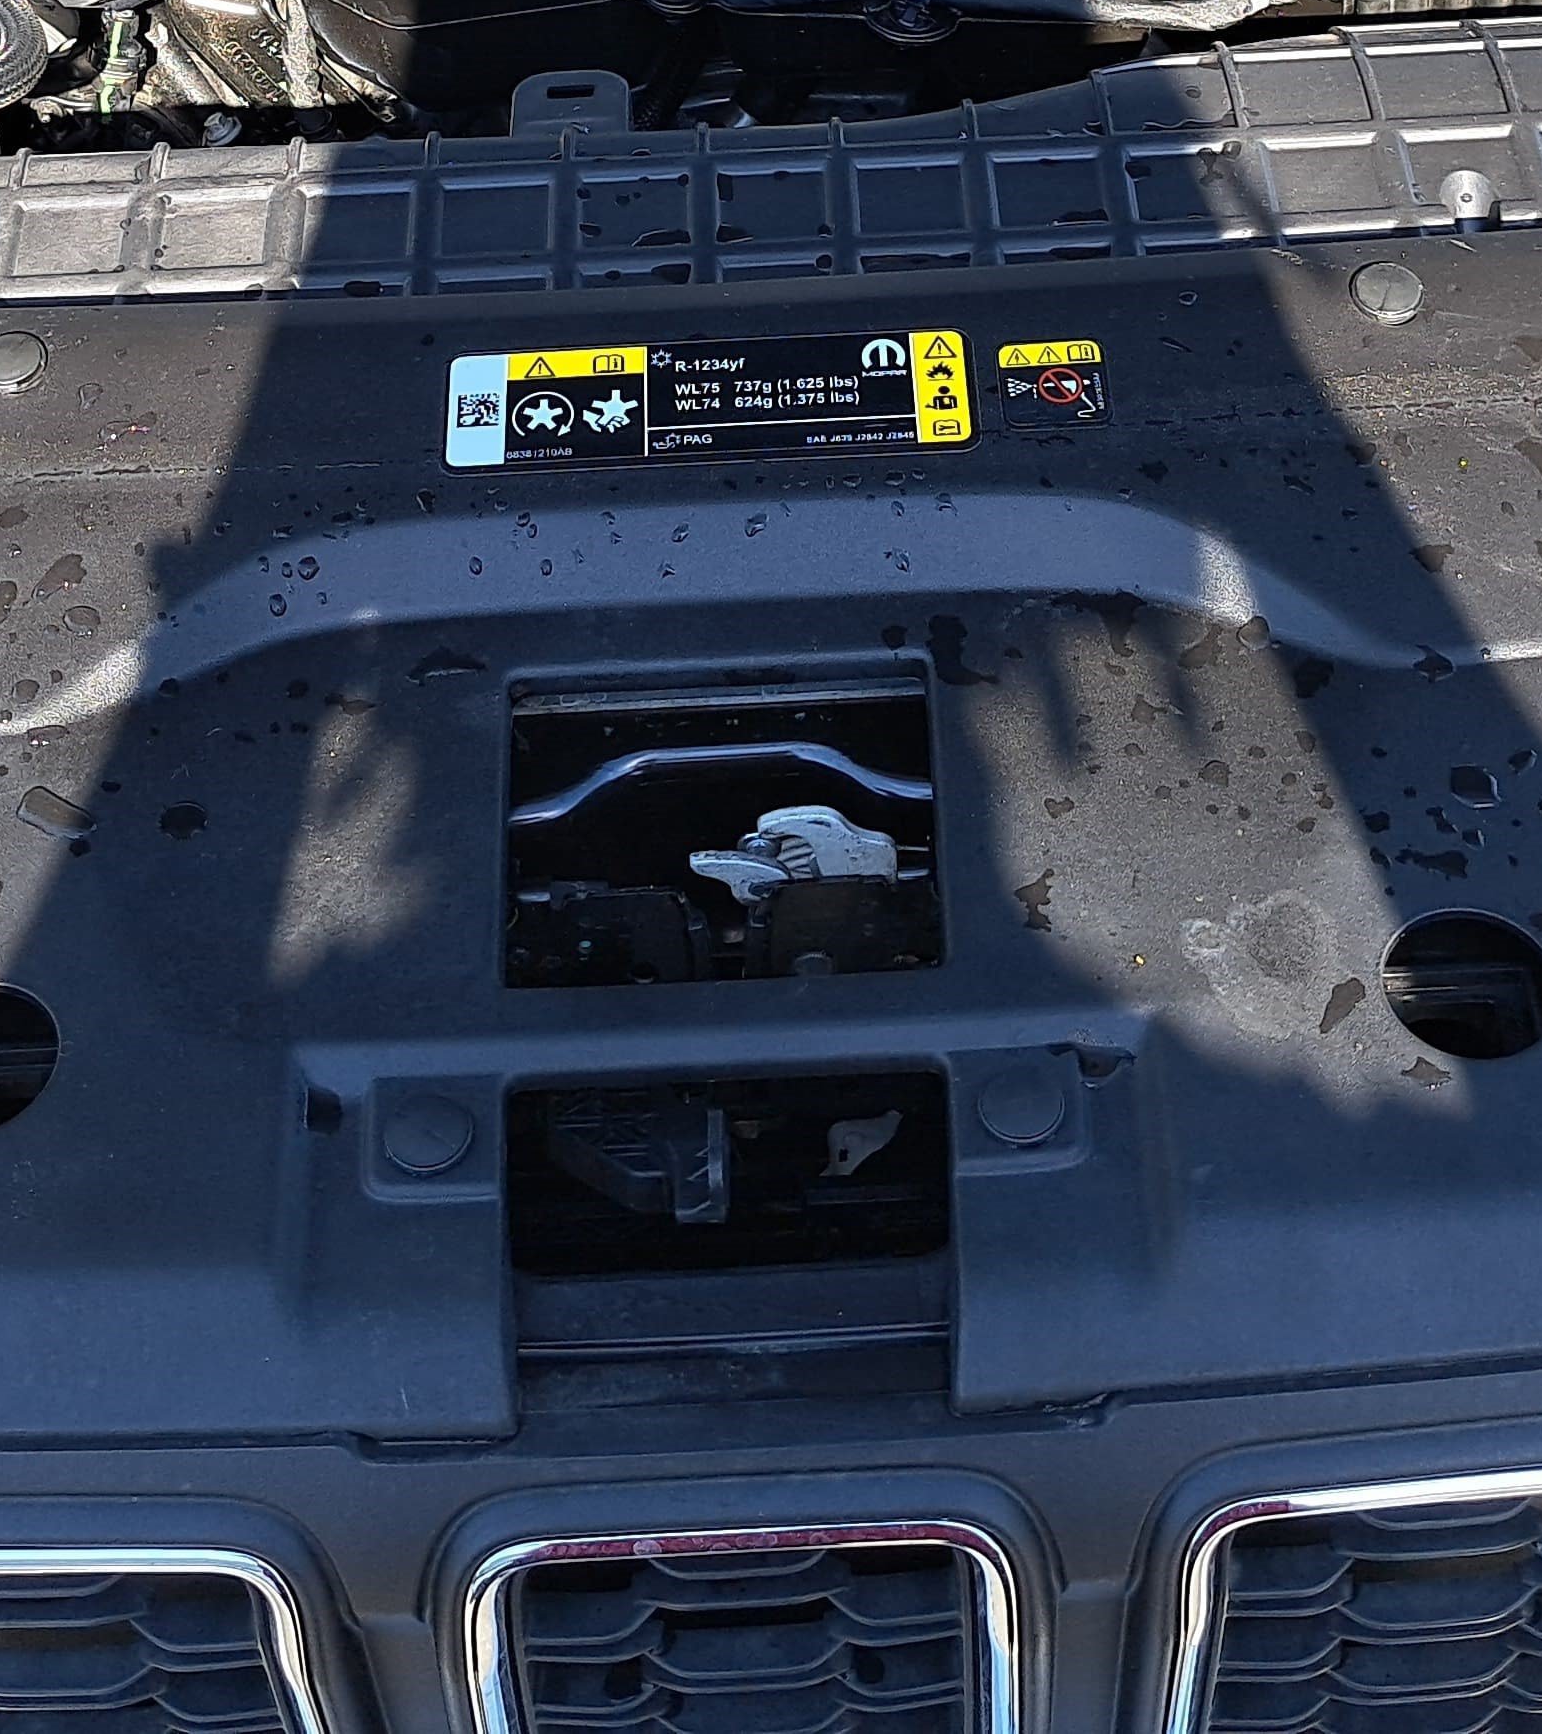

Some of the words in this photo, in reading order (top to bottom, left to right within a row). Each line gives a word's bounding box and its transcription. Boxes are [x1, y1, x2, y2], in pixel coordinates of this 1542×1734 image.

[674, 357, 746, 372] R-1234yf
[861, 369, 908, 378] MOPAR
[675, 382, 720, 395] WL75
[734, 380, 772, 394] 737g
[777, 377, 825, 393] (1.625
[829, 375, 859, 389] lbs)
[675, 398, 721, 410] WL74
[734, 395, 773, 409] 624g
[777, 393, 826, 408] (1.375
[830, 391, 860, 405] lbs)
[683, 434, 713, 445] PAG
